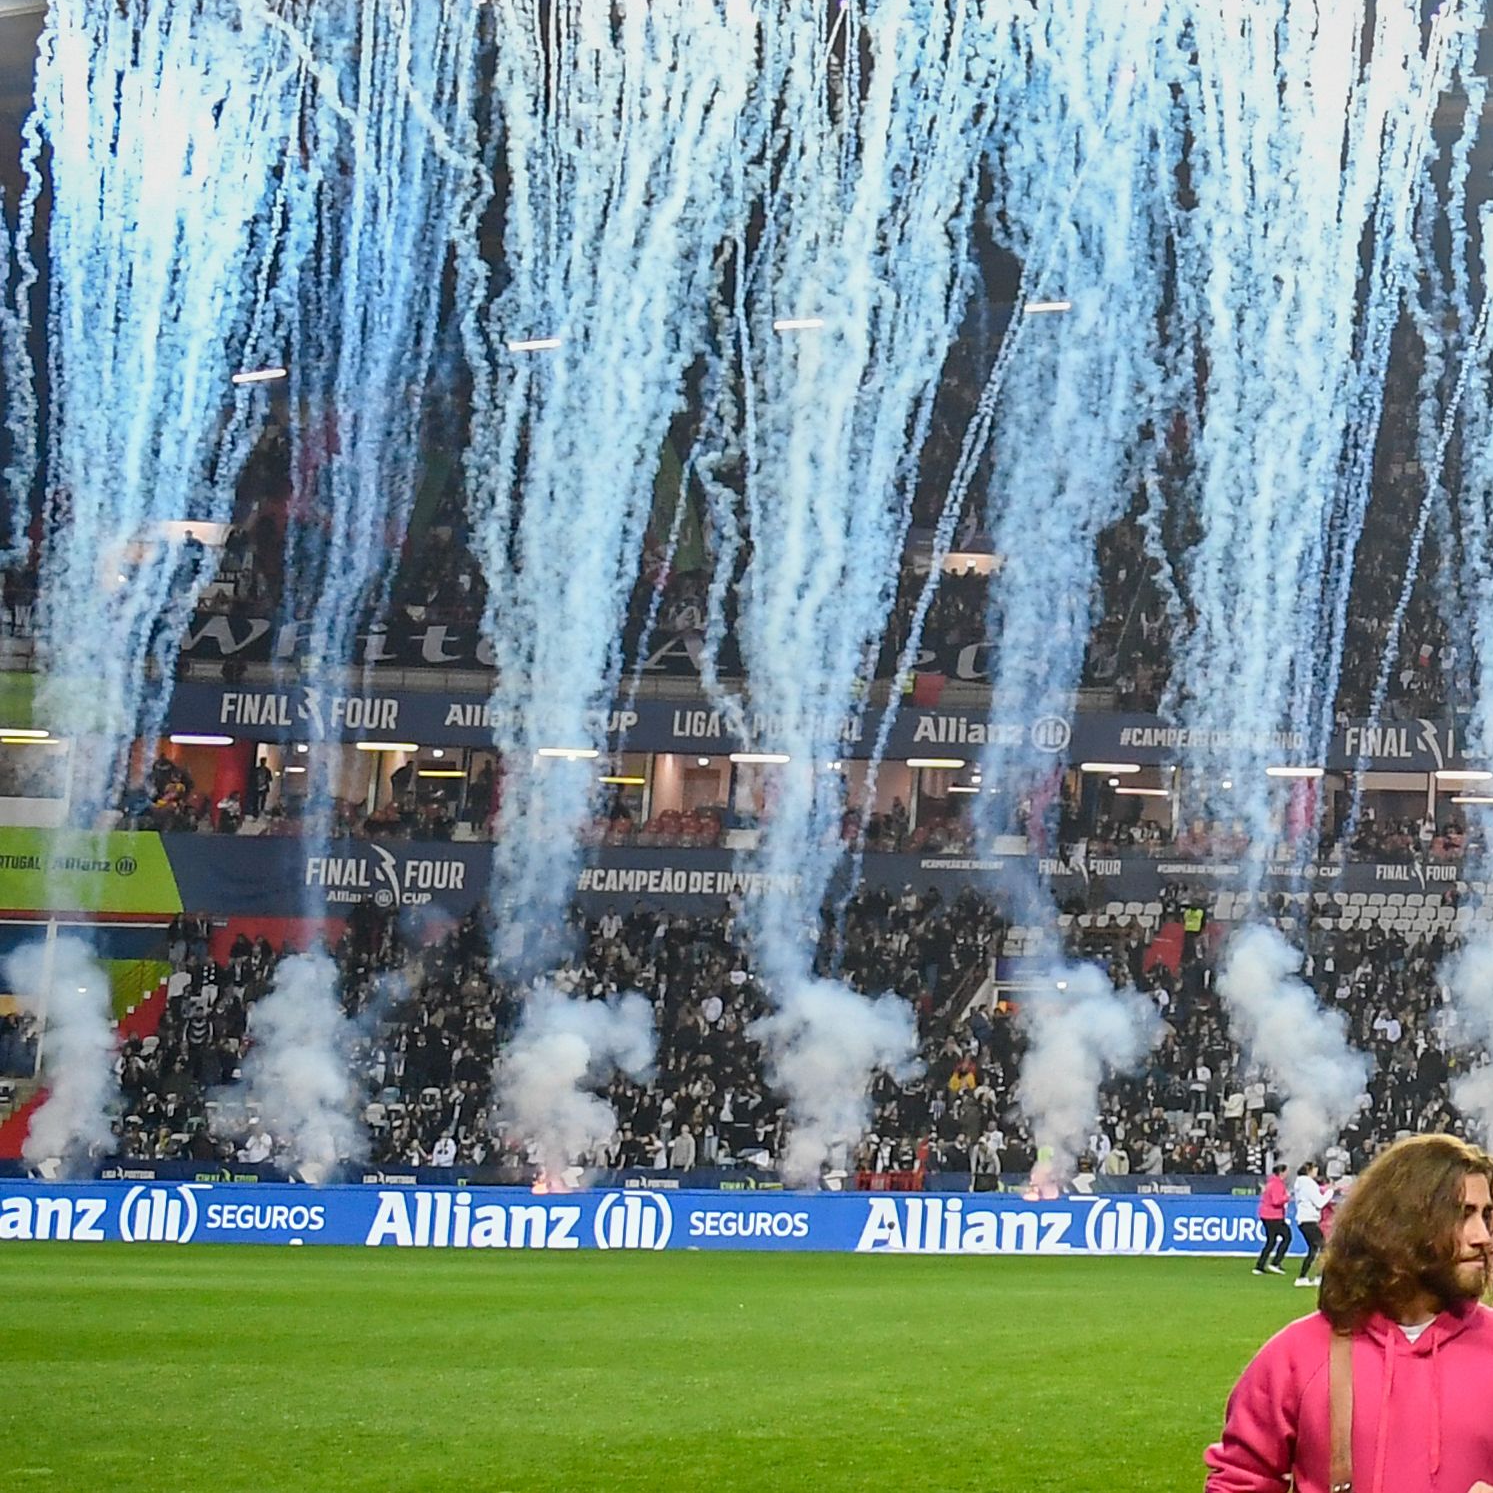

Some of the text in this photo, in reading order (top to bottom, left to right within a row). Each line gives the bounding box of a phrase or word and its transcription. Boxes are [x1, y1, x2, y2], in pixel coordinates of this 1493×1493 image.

[220, 692, 399, 730] FINAL FOUR
[673, 710, 721, 738] LIGA
[1345, 727, 1413, 758] FINAL
[305, 857, 465, 890] FINAL FOUR
[1089, 859, 1121, 876] FOUR
[1319, 866, 1342, 877] CUP
[1375, 864, 1457, 882] FINAL FOUR
[401, 892, 432, 905] CUP
[206, 1204, 326, 1231] SEGUROS
[365, 1191, 809, 1249] Allianz SEGUROS
[855, 1197, 1270, 1252] Allianz SEGURO
